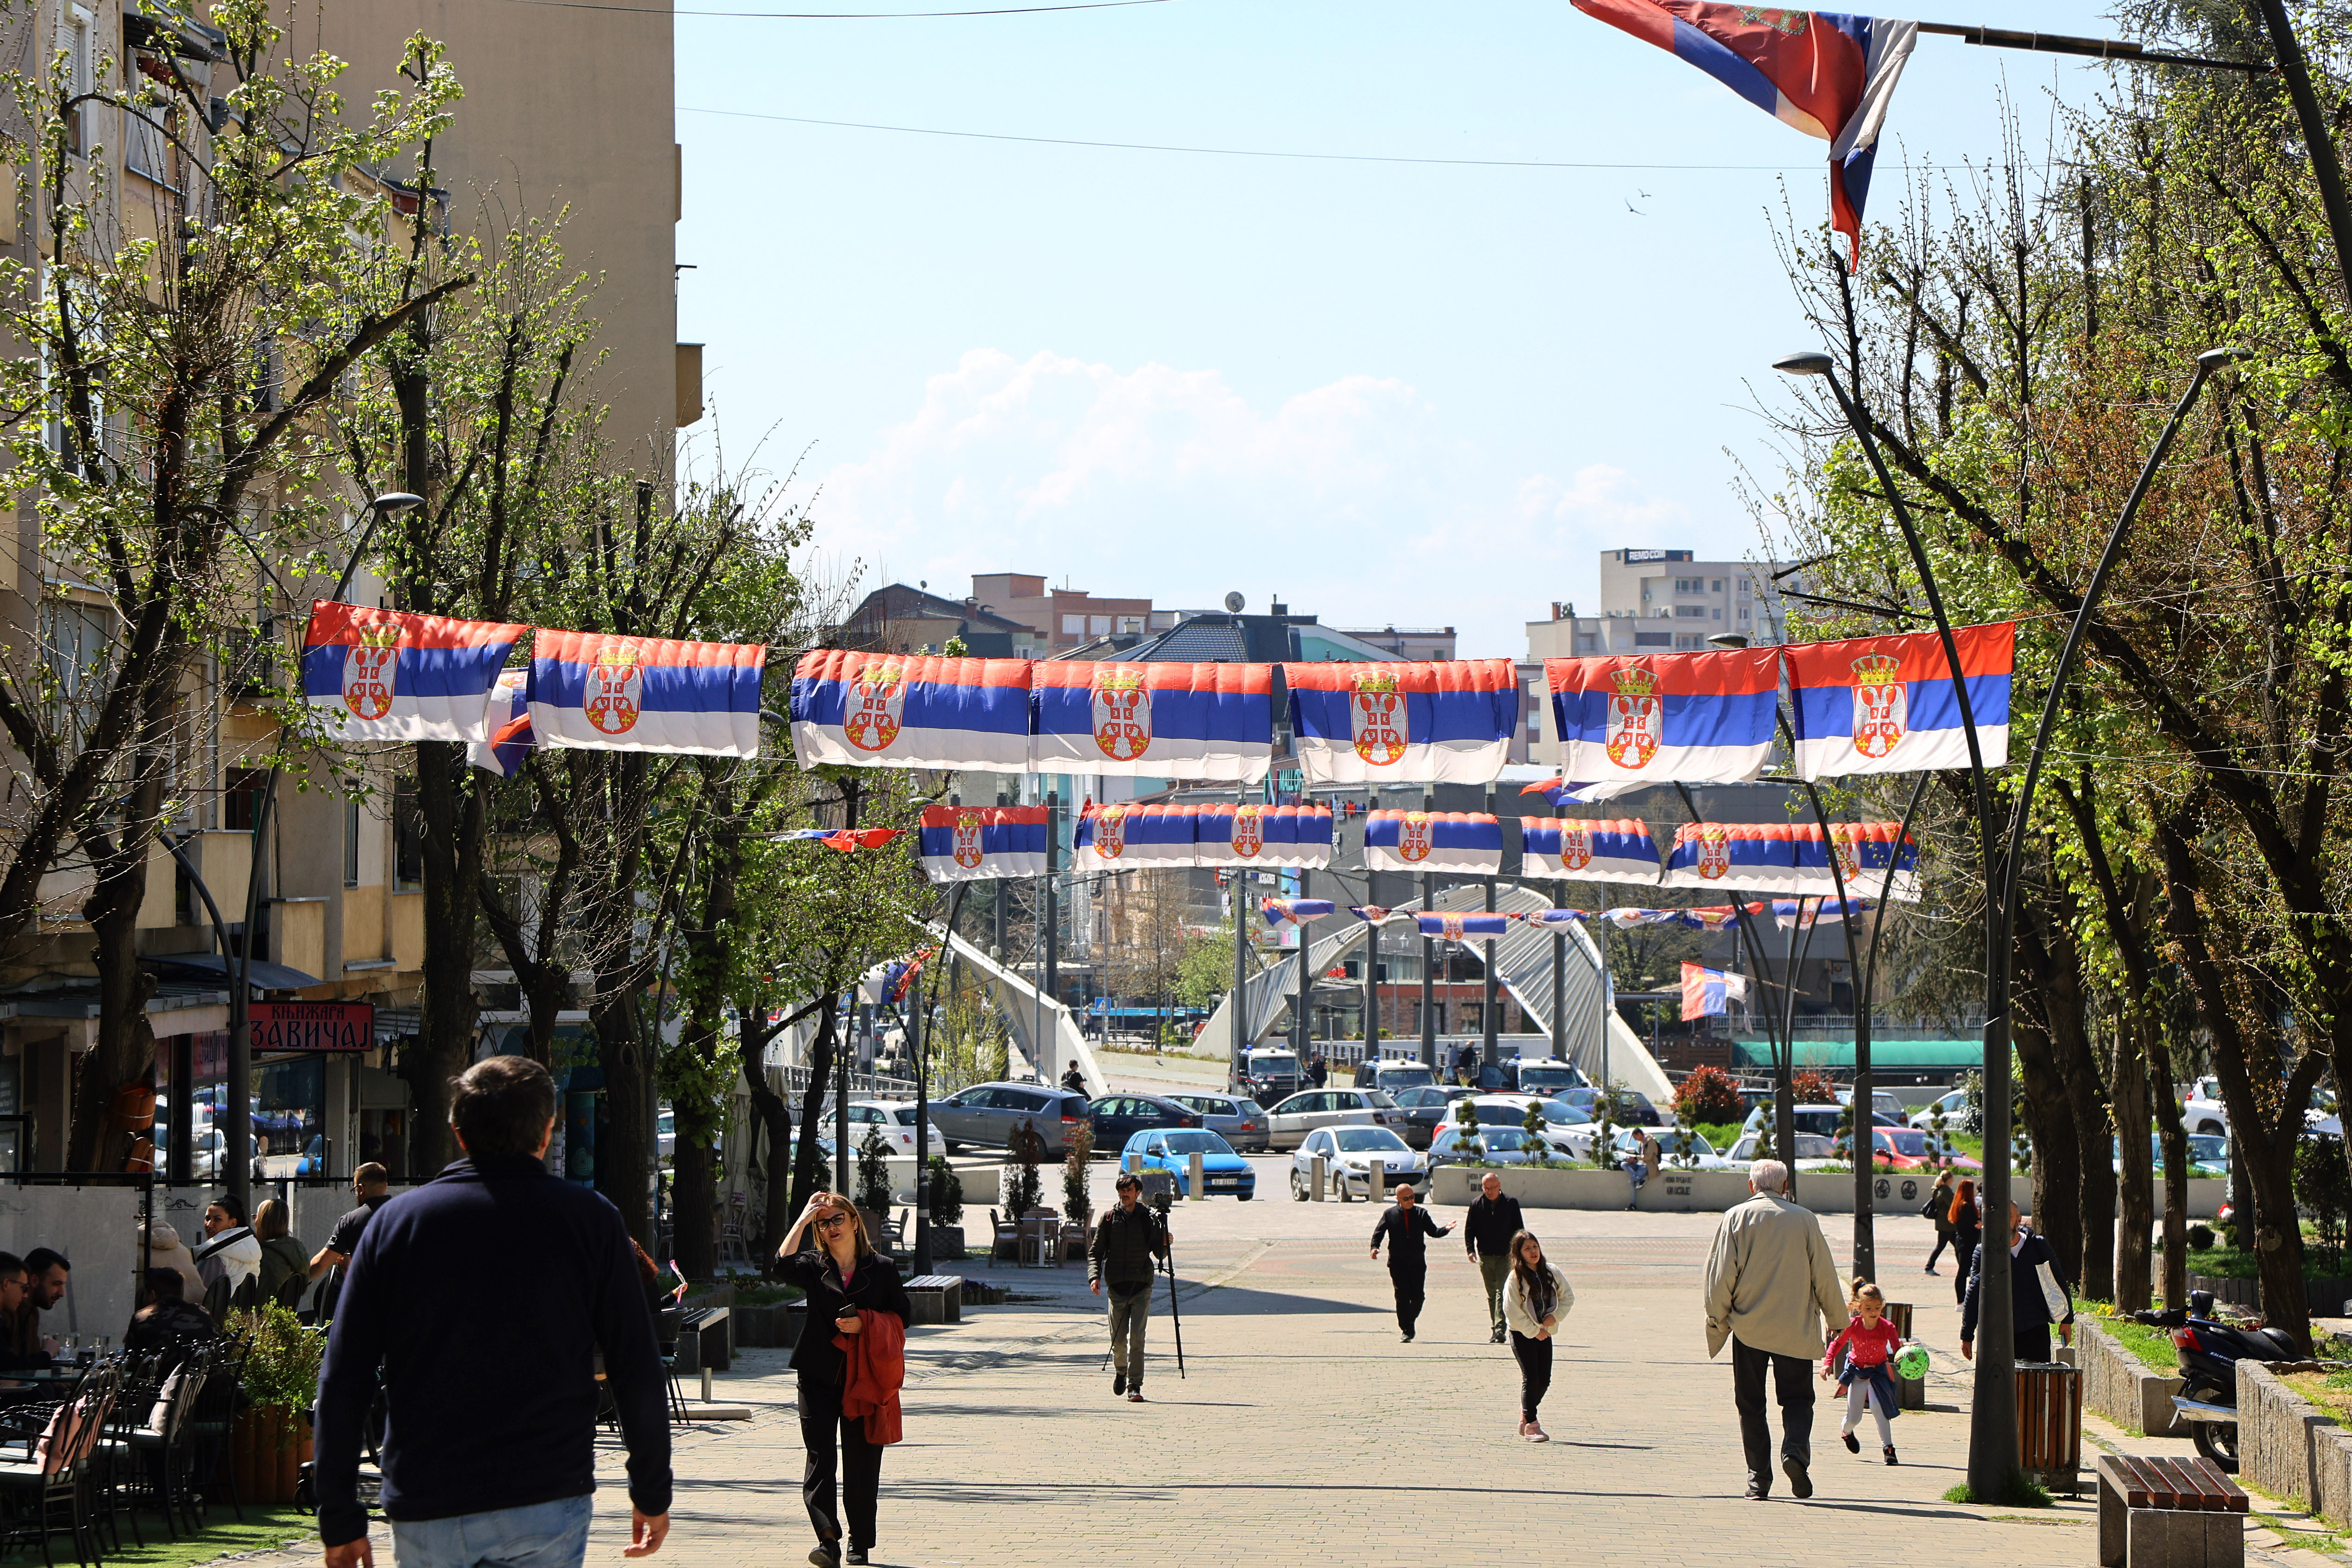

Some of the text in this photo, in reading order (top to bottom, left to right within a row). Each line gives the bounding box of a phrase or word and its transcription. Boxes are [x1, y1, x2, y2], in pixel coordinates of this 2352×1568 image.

[1279, 769, 1294, 791] MALL
[272, 1006, 345, 1019] КЊИЖАРА
[250, 1020, 369, 1048] ЗАВИЧАЈ
